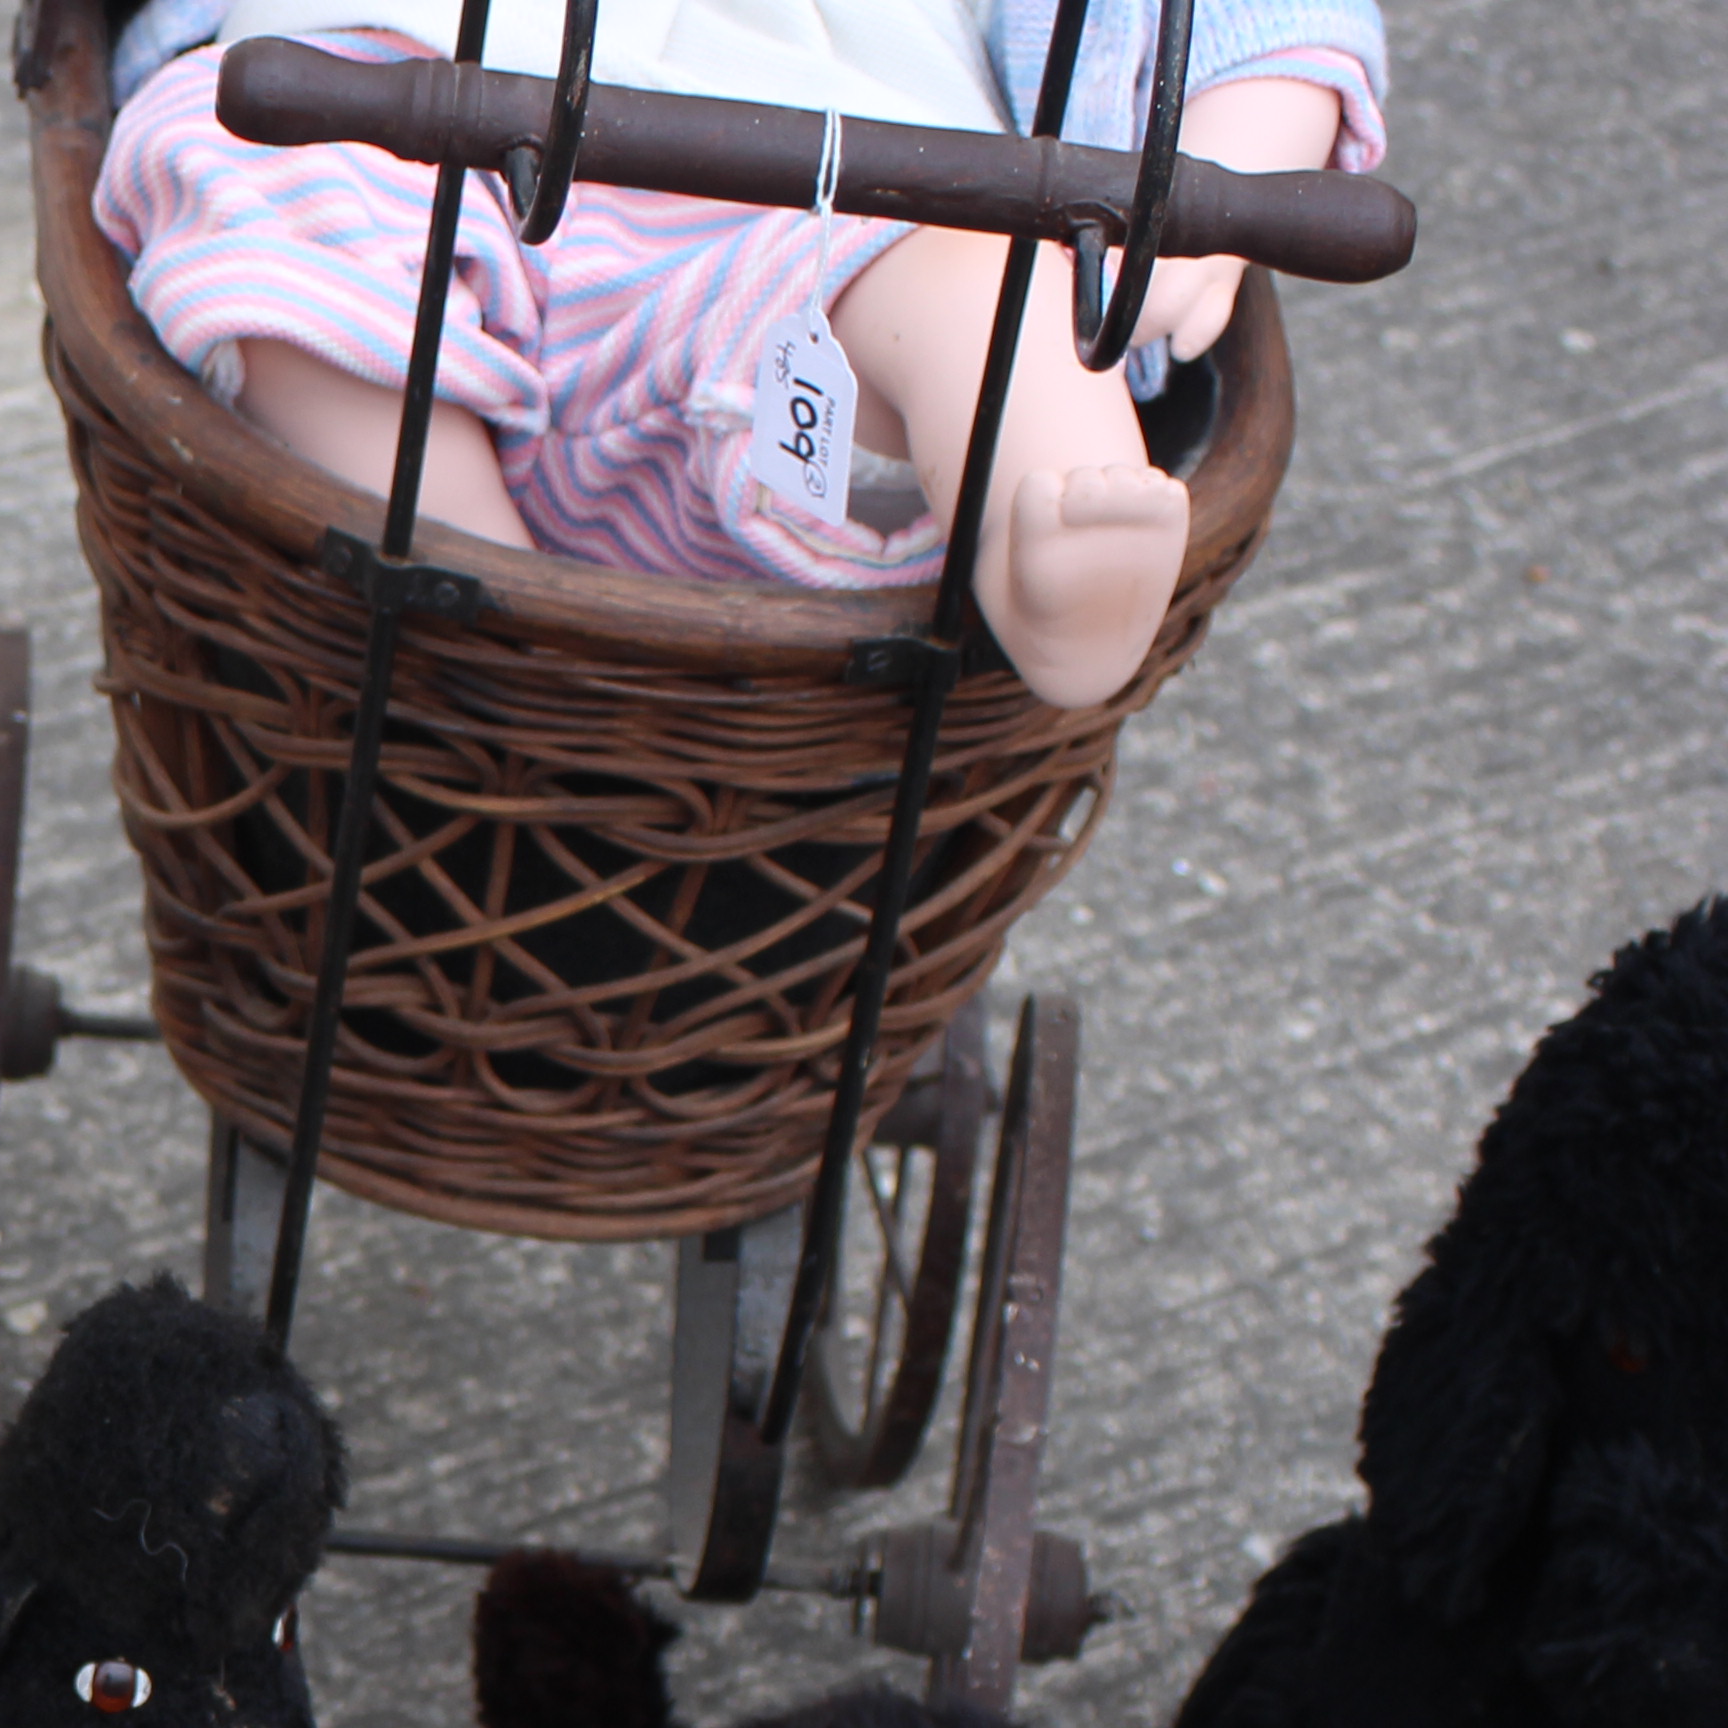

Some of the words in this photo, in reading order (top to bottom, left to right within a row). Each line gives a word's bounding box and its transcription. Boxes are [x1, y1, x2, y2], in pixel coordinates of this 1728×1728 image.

[778, 377, 824, 463] 109
[823, 397, 836, 435] PART
[819, 437, 830, 467] LOT
